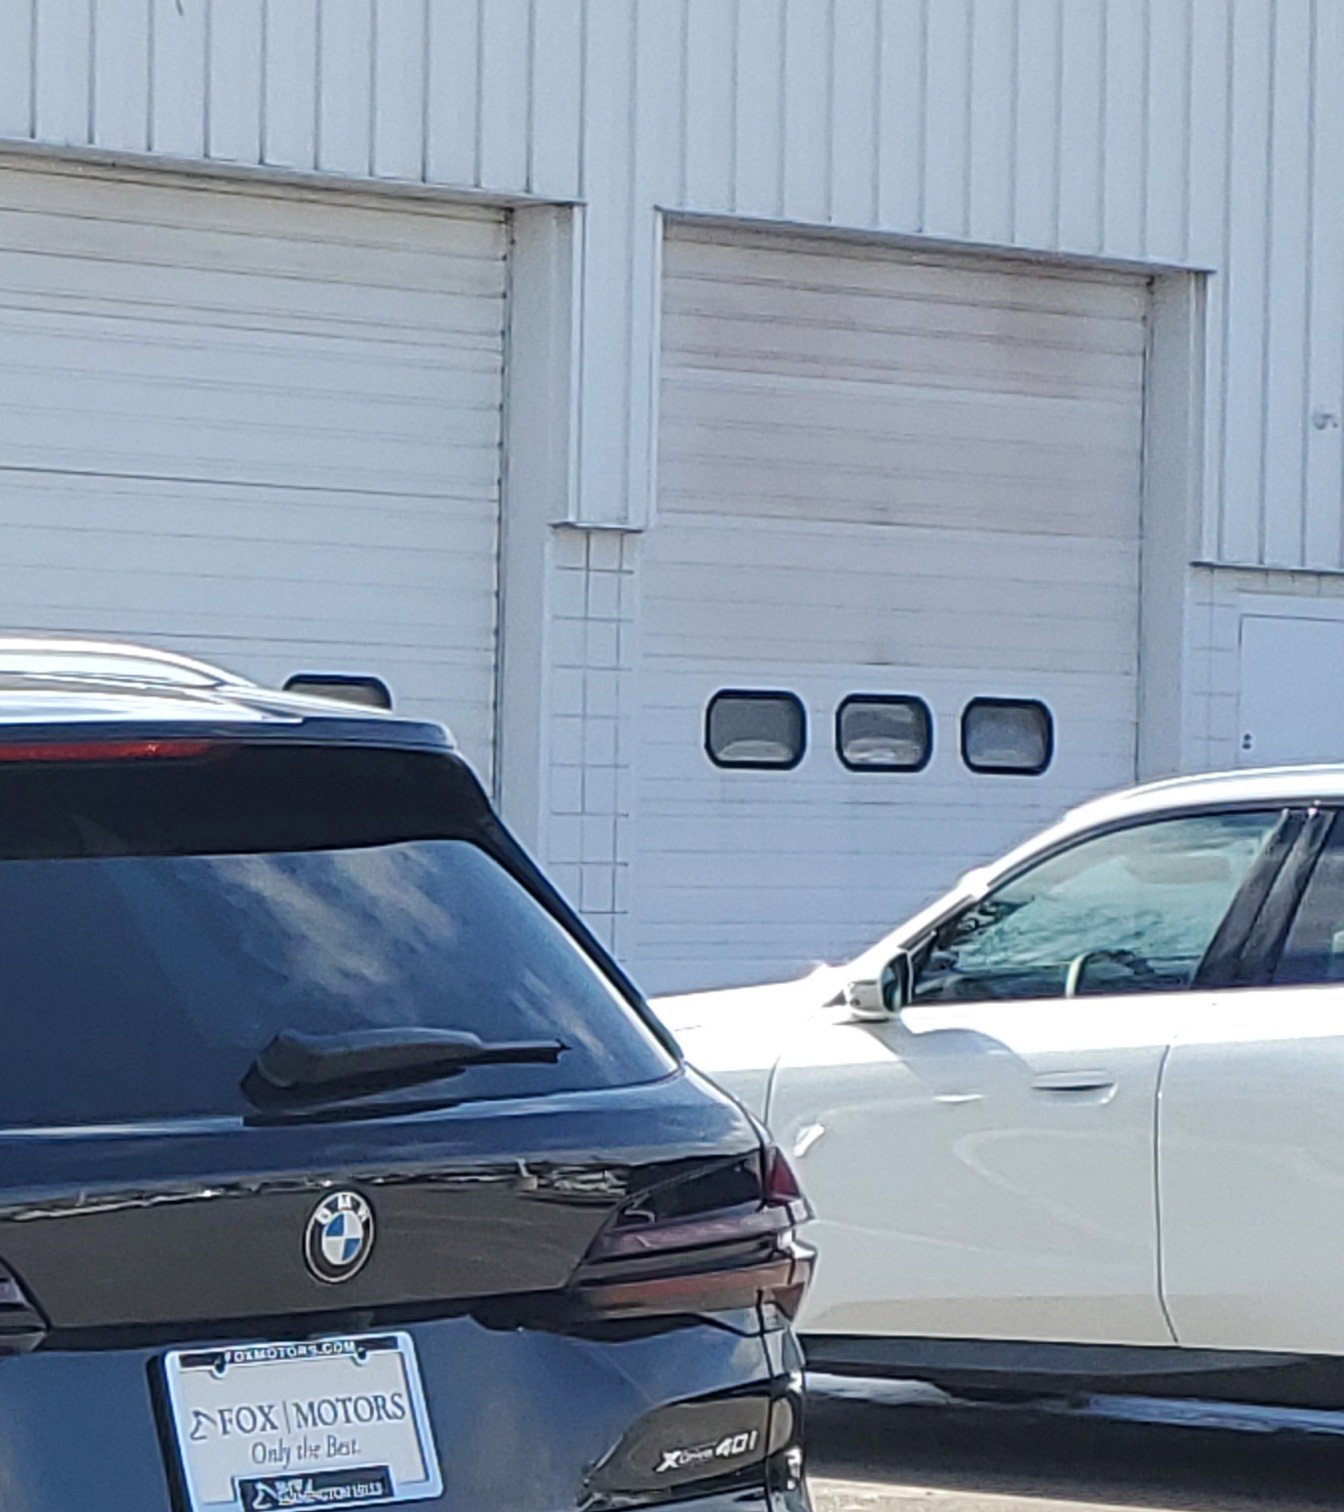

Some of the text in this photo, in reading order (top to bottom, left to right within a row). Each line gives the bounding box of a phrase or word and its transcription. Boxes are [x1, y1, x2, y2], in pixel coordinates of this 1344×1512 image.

[218, 1392, 406, 1435] FOX MOTORS
[252, 1438, 291, 1470] Only
[297, 1436, 321, 1461] the
